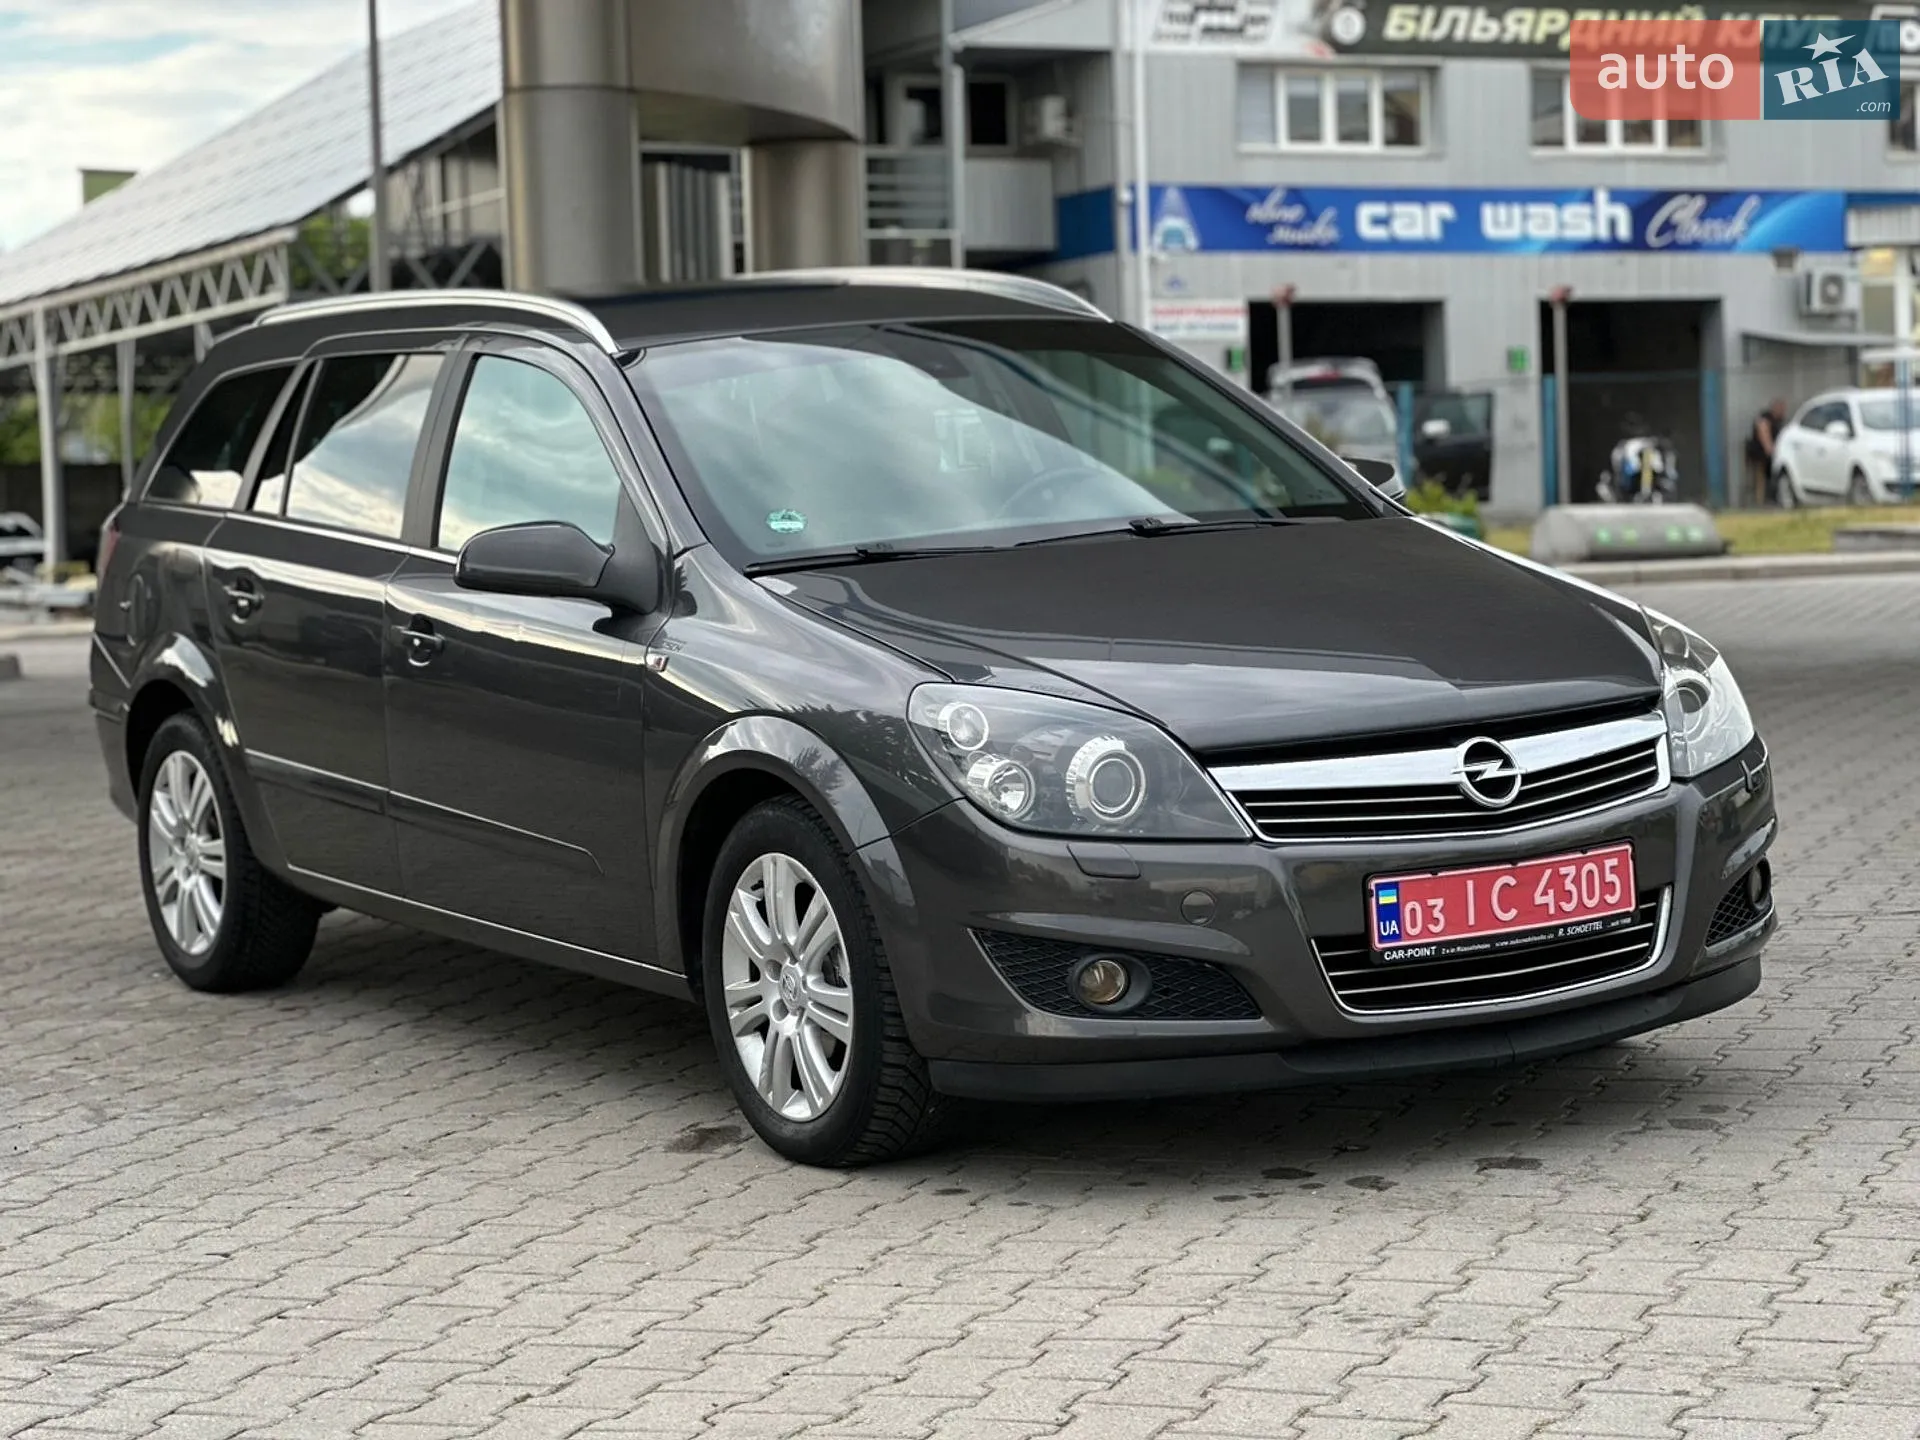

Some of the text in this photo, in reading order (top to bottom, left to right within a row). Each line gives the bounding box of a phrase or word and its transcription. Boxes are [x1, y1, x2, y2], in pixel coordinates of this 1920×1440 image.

[1355, 201, 1456, 242] car
[1480, 189, 1634, 243] wash
[1404, 898, 1445, 936] 03
[1533, 858, 1622, 914] 4305
[1380, 919, 1400, 936] UA
[1384, 946, 1437, 960] CAR-POINT
